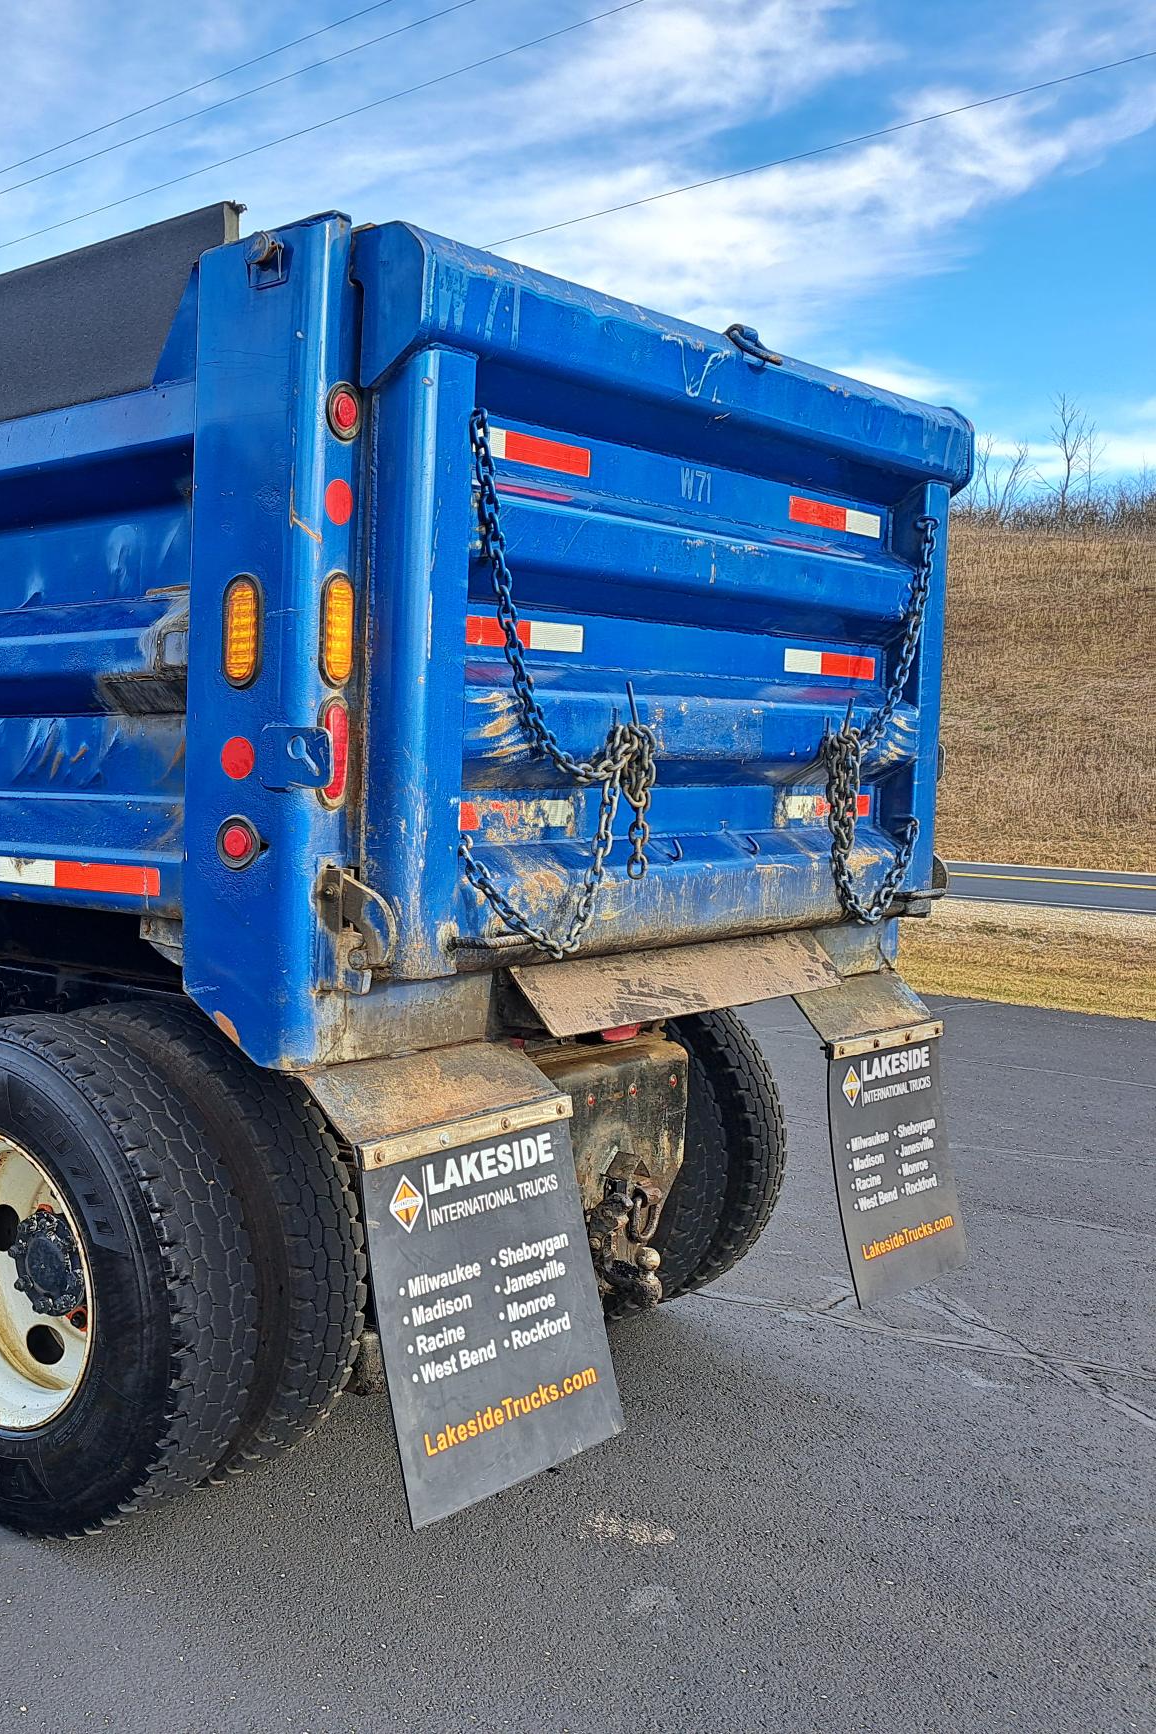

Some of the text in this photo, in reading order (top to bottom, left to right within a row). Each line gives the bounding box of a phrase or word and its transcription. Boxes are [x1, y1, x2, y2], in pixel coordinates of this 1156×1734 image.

[680, 466, 712, 505] W71
[863, 1045, 931, 1082] LAKESIDE
[864, 1075, 932, 1105] INTERNATIONAL TRUCKS
[850, 1131, 890, 1152] Milwaukee
[897, 1118, 936, 1138] Sheboygan
[852, 1153, 885, 1172] Madison
[900, 1136, 934, 1158] Janesville
[426, 1132, 555, 1196] LAKESIDE
[901, 1159, 929, 1177] Monroe
[855, 1174, 882, 1192] Racine
[857, 1186, 899, 1212] West Bend
[904, 1173, 938, 1196] Rockford
[430, 1173, 559, 1227] INTERNATIONAL TRUCKS
[498, 1233, 570, 1268] Sheboygan
[862, 1214, 954, 1261] LakesideTrucks.com
[407, 1262, 482, 1298] Milwaukee
[503, 1260, 566, 1296] Janesville
[411, 1294, 473, 1327] Madison
[506, 1293, 556, 1323] Monroe
[416, 1325, 466, 1356] Racine
[511, 1311, 572, 1350] Rockford
[420, 1339, 498, 1384] West Bend
[422, 1366, 598, 1458] LakesideTrucks.com
